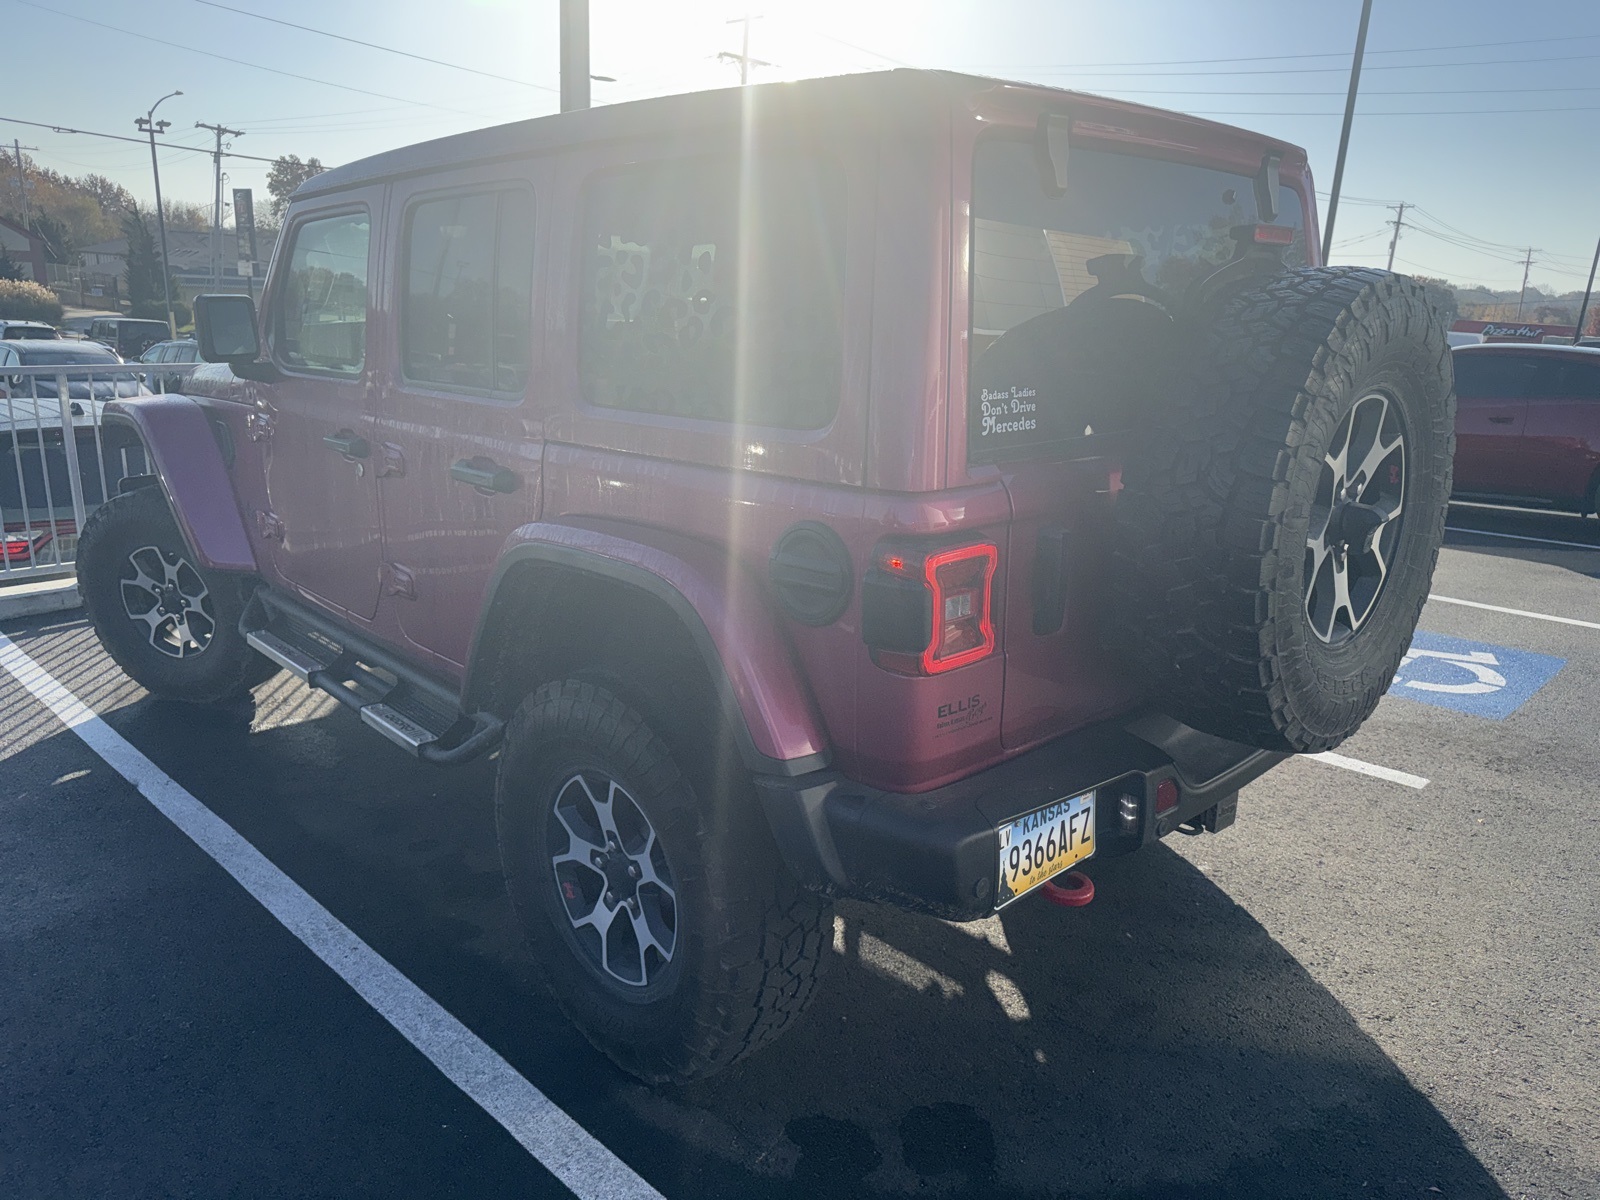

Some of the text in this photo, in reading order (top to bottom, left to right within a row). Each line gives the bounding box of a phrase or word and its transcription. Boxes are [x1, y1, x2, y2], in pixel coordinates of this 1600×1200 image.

[1482, 324, 1544, 338] Pizza Hut
[981, 386, 1036, 401] Badass Ladies
[981, 399, 1036, 416] Don't Drive
[981, 416, 1037, 436] Mercedes
[937, 694, 981, 719] ELLIS
[1022, 800, 1071, 835] KANSAS
[1009, 806, 1091, 882] 9366AFZ
[1037, 866, 1047, 880] the
[1048, 861, 1063, 875] stars
